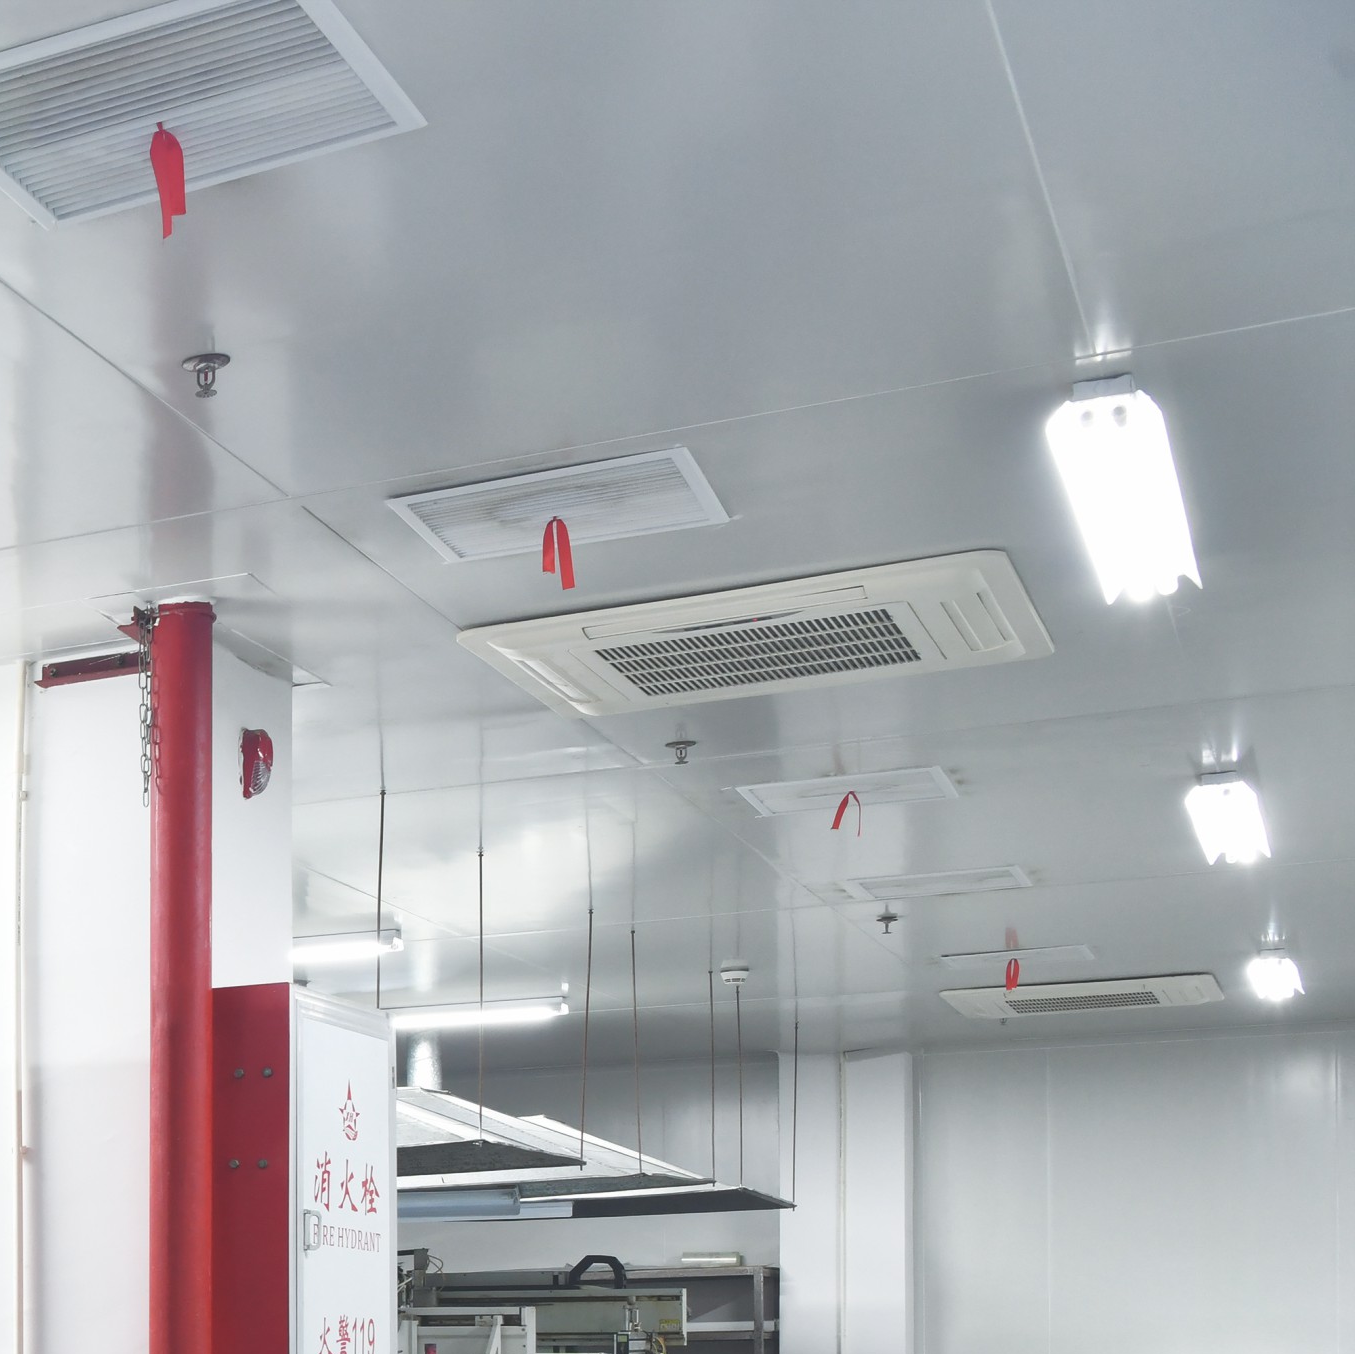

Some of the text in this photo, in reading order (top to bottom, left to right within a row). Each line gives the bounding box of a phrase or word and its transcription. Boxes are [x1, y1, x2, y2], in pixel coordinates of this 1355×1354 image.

[313, 1151, 381, 1216] 消火栓
[313, 1224, 382, 1253] FRE HYDRANT
